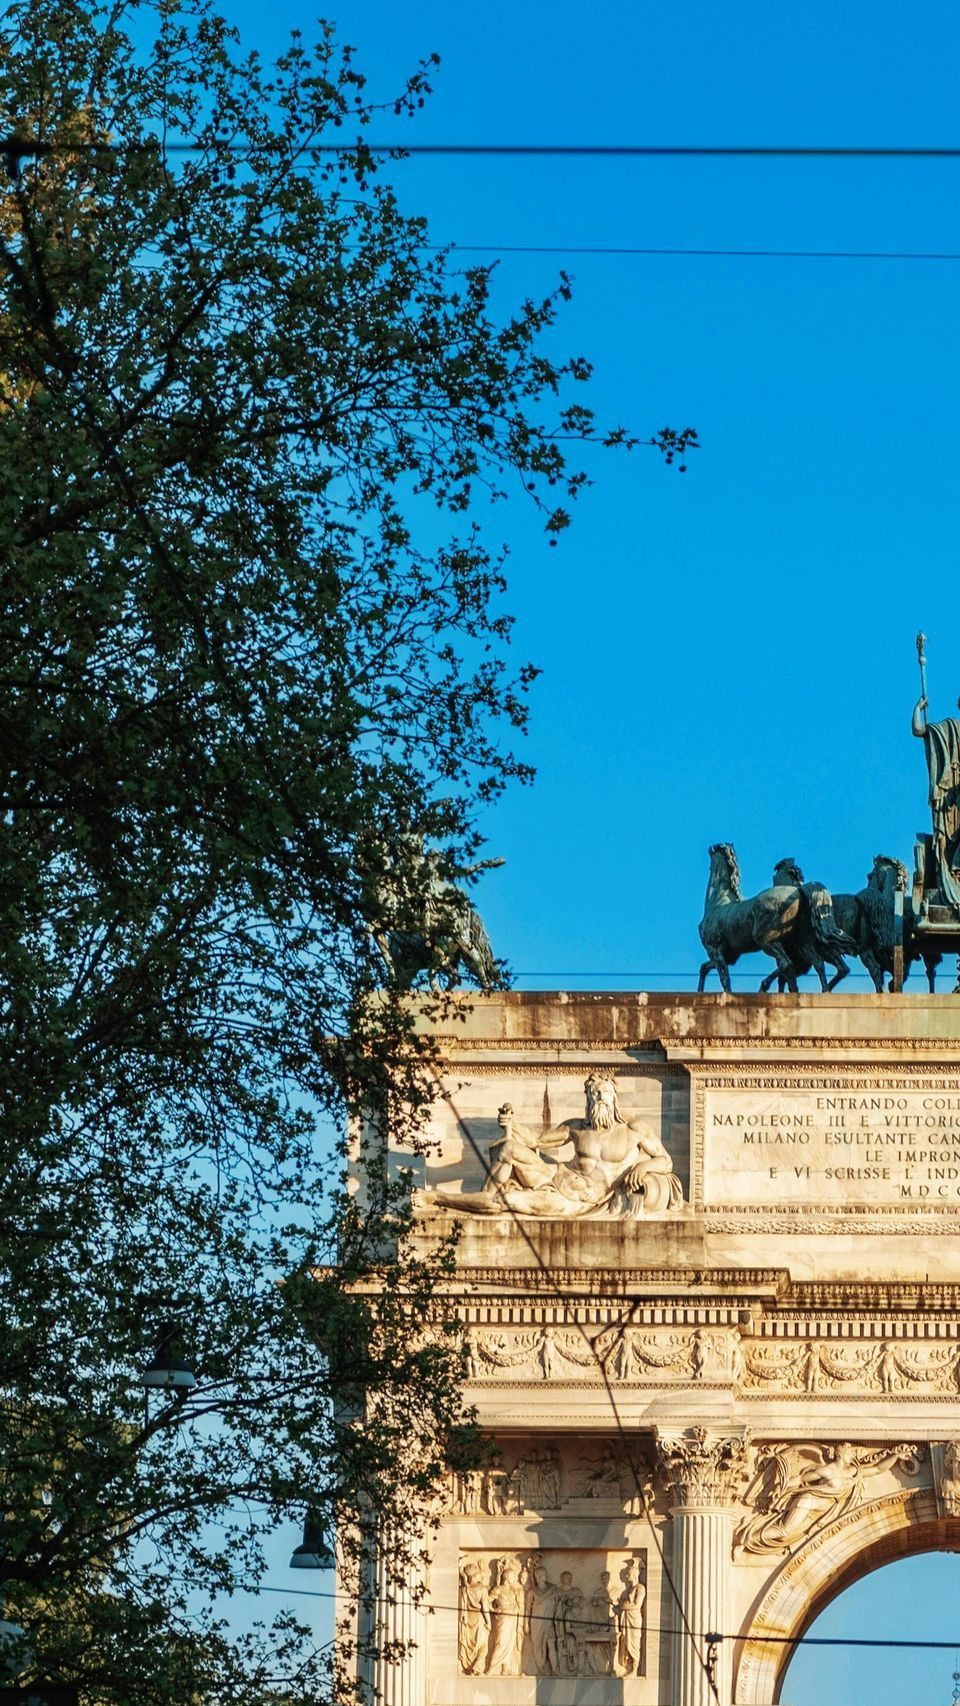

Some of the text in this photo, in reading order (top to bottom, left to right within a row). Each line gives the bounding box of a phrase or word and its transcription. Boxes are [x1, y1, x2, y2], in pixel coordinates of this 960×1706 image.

[816, 1098, 908, 1111] ENTRANDO
[712, 1115, 814, 1129] NAPOLEONE
[828, 1115, 845, 1129] III
[860, 1115, 869, 1129] E
[743, 1133, 810, 1146] MILANO
[824, 1133, 916, 1146] ESULTANTE
[865, 1150, 883, 1163] LE
[769, 1167, 777, 1180] E
[794, 1167, 811, 1180] VI
[824, 1167, 891, 1180] SCRISSE
